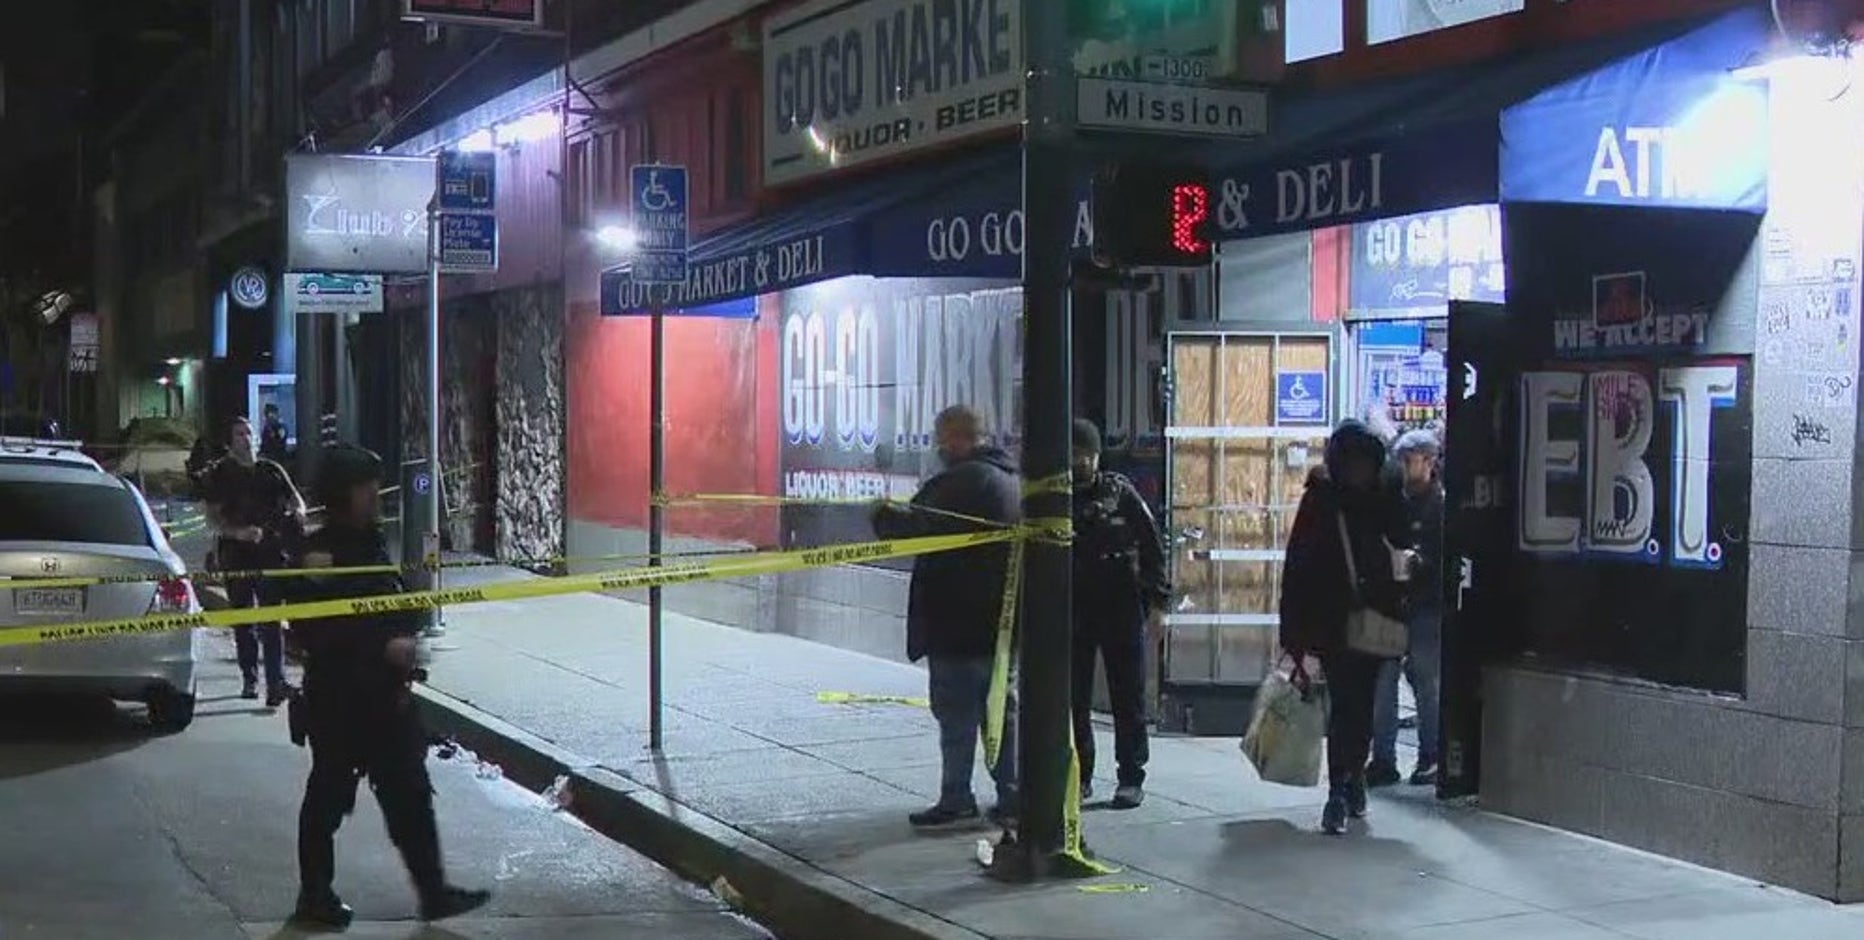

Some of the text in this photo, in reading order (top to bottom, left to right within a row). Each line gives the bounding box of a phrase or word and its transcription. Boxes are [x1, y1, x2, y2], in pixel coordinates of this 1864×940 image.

[875, 0, 1012, 108] MARKE
[936, 88, 1020, 131] BEER
[1105, 88, 1243, 127] Mission
[1217, 152, 1383, 230] & DELI
[927, 217, 970, 261] GO
[980, 209, 1023, 256] GO
[754, 250, 770, 288] &
[777, 235, 824, 282] DELI
[1554, 311, 1709, 349] WE ACCEPT
[783, 309, 878, 454] GO-GO
[892, 286, 1023, 453] MARKE
[785, 470, 839, 500] LIQUOR
